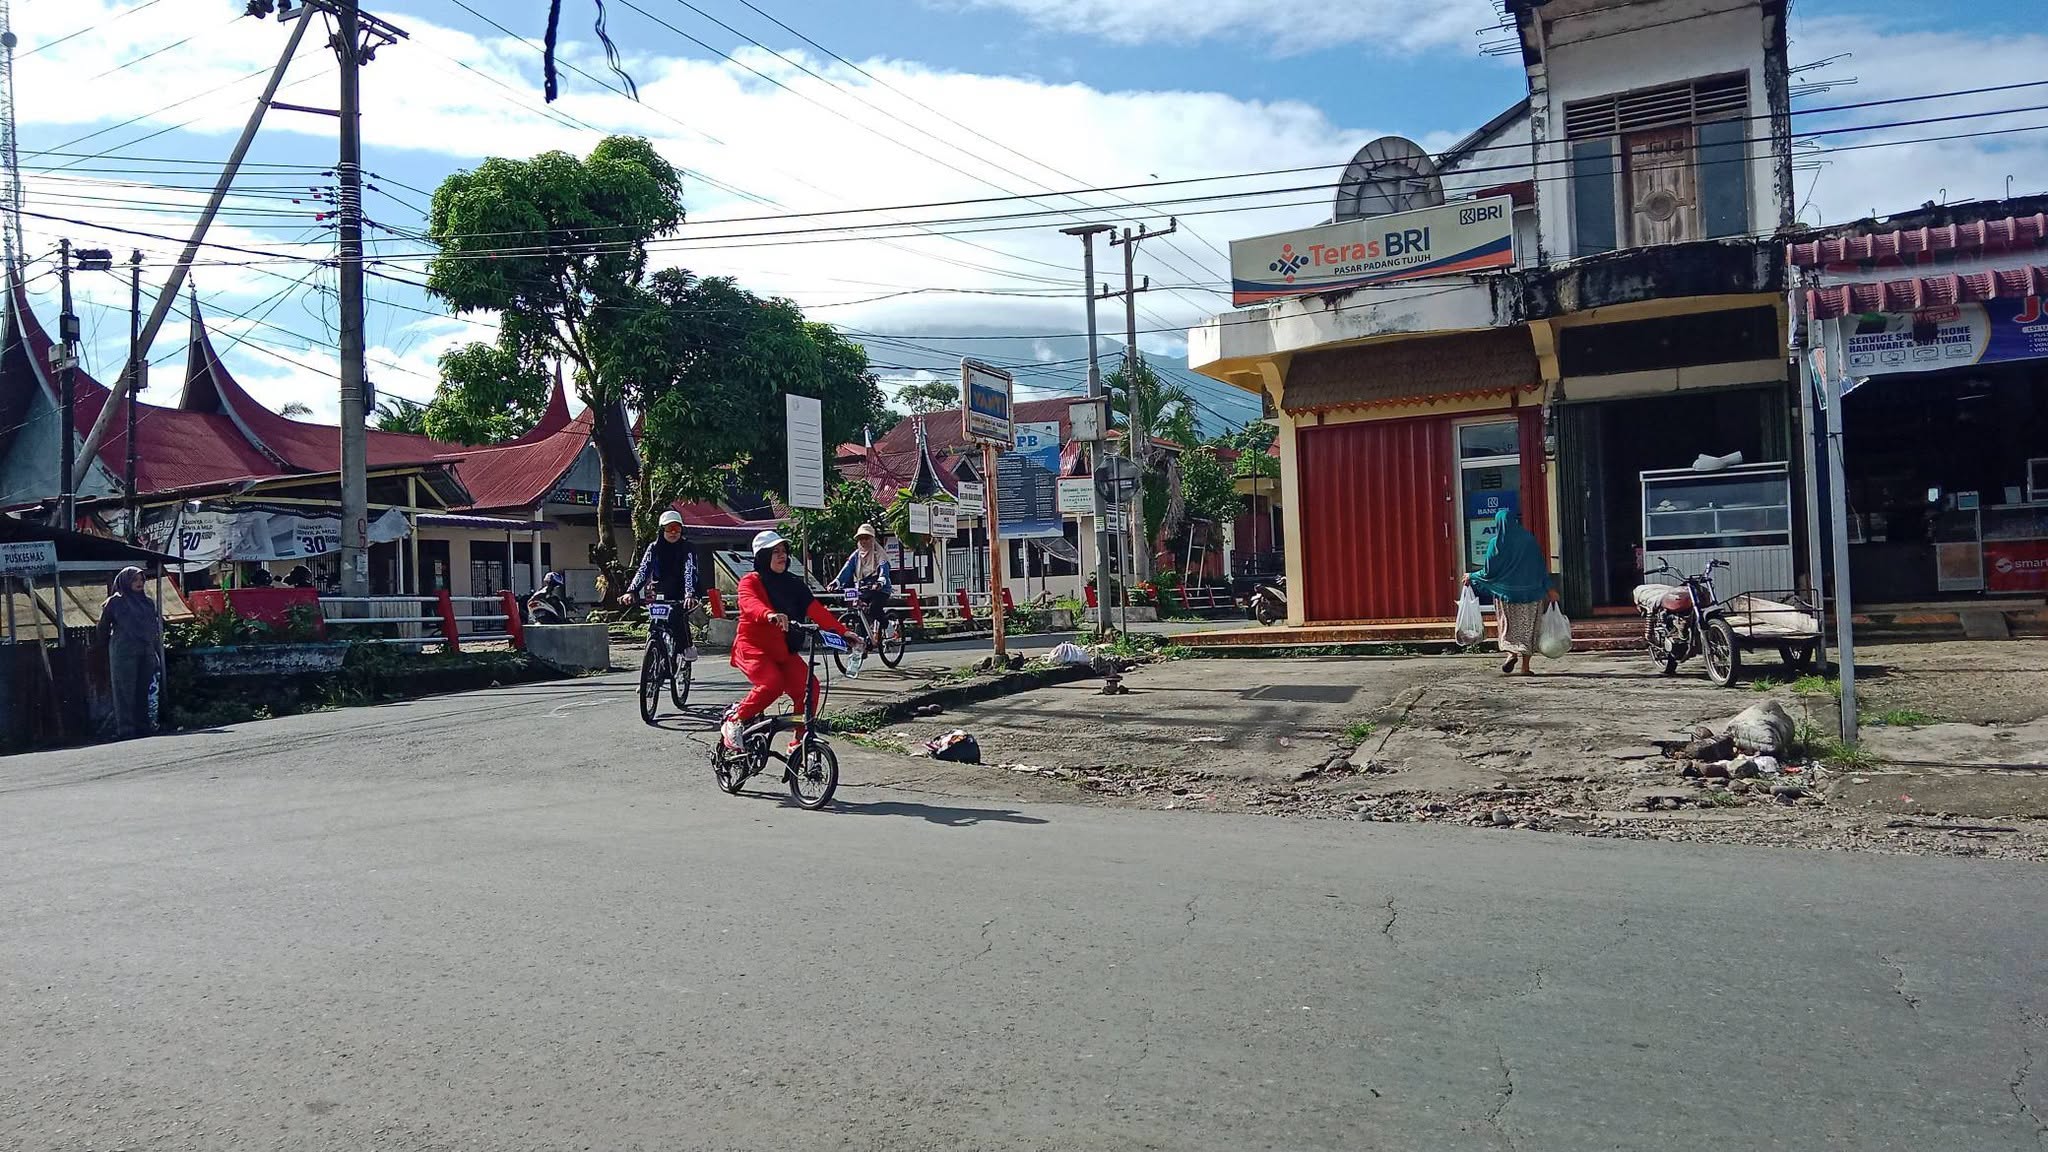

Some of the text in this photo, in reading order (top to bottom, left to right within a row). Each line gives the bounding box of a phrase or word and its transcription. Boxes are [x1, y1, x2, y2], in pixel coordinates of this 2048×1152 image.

[1476, 204, 1502, 222] BRI
[1308, 226, 1430, 267] Teras BRI
[1334, 254, 1431, 275] PASAR PADANG TUJUH
[1849, 333, 1894, 345] SERVICE
[1849, 340, 1905, 353] HARDWARE
[1482, 526, 1497, 535] AT
[302, 536, 327, 554] 30
[5, 552, 45, 563] PUSKESMAS
